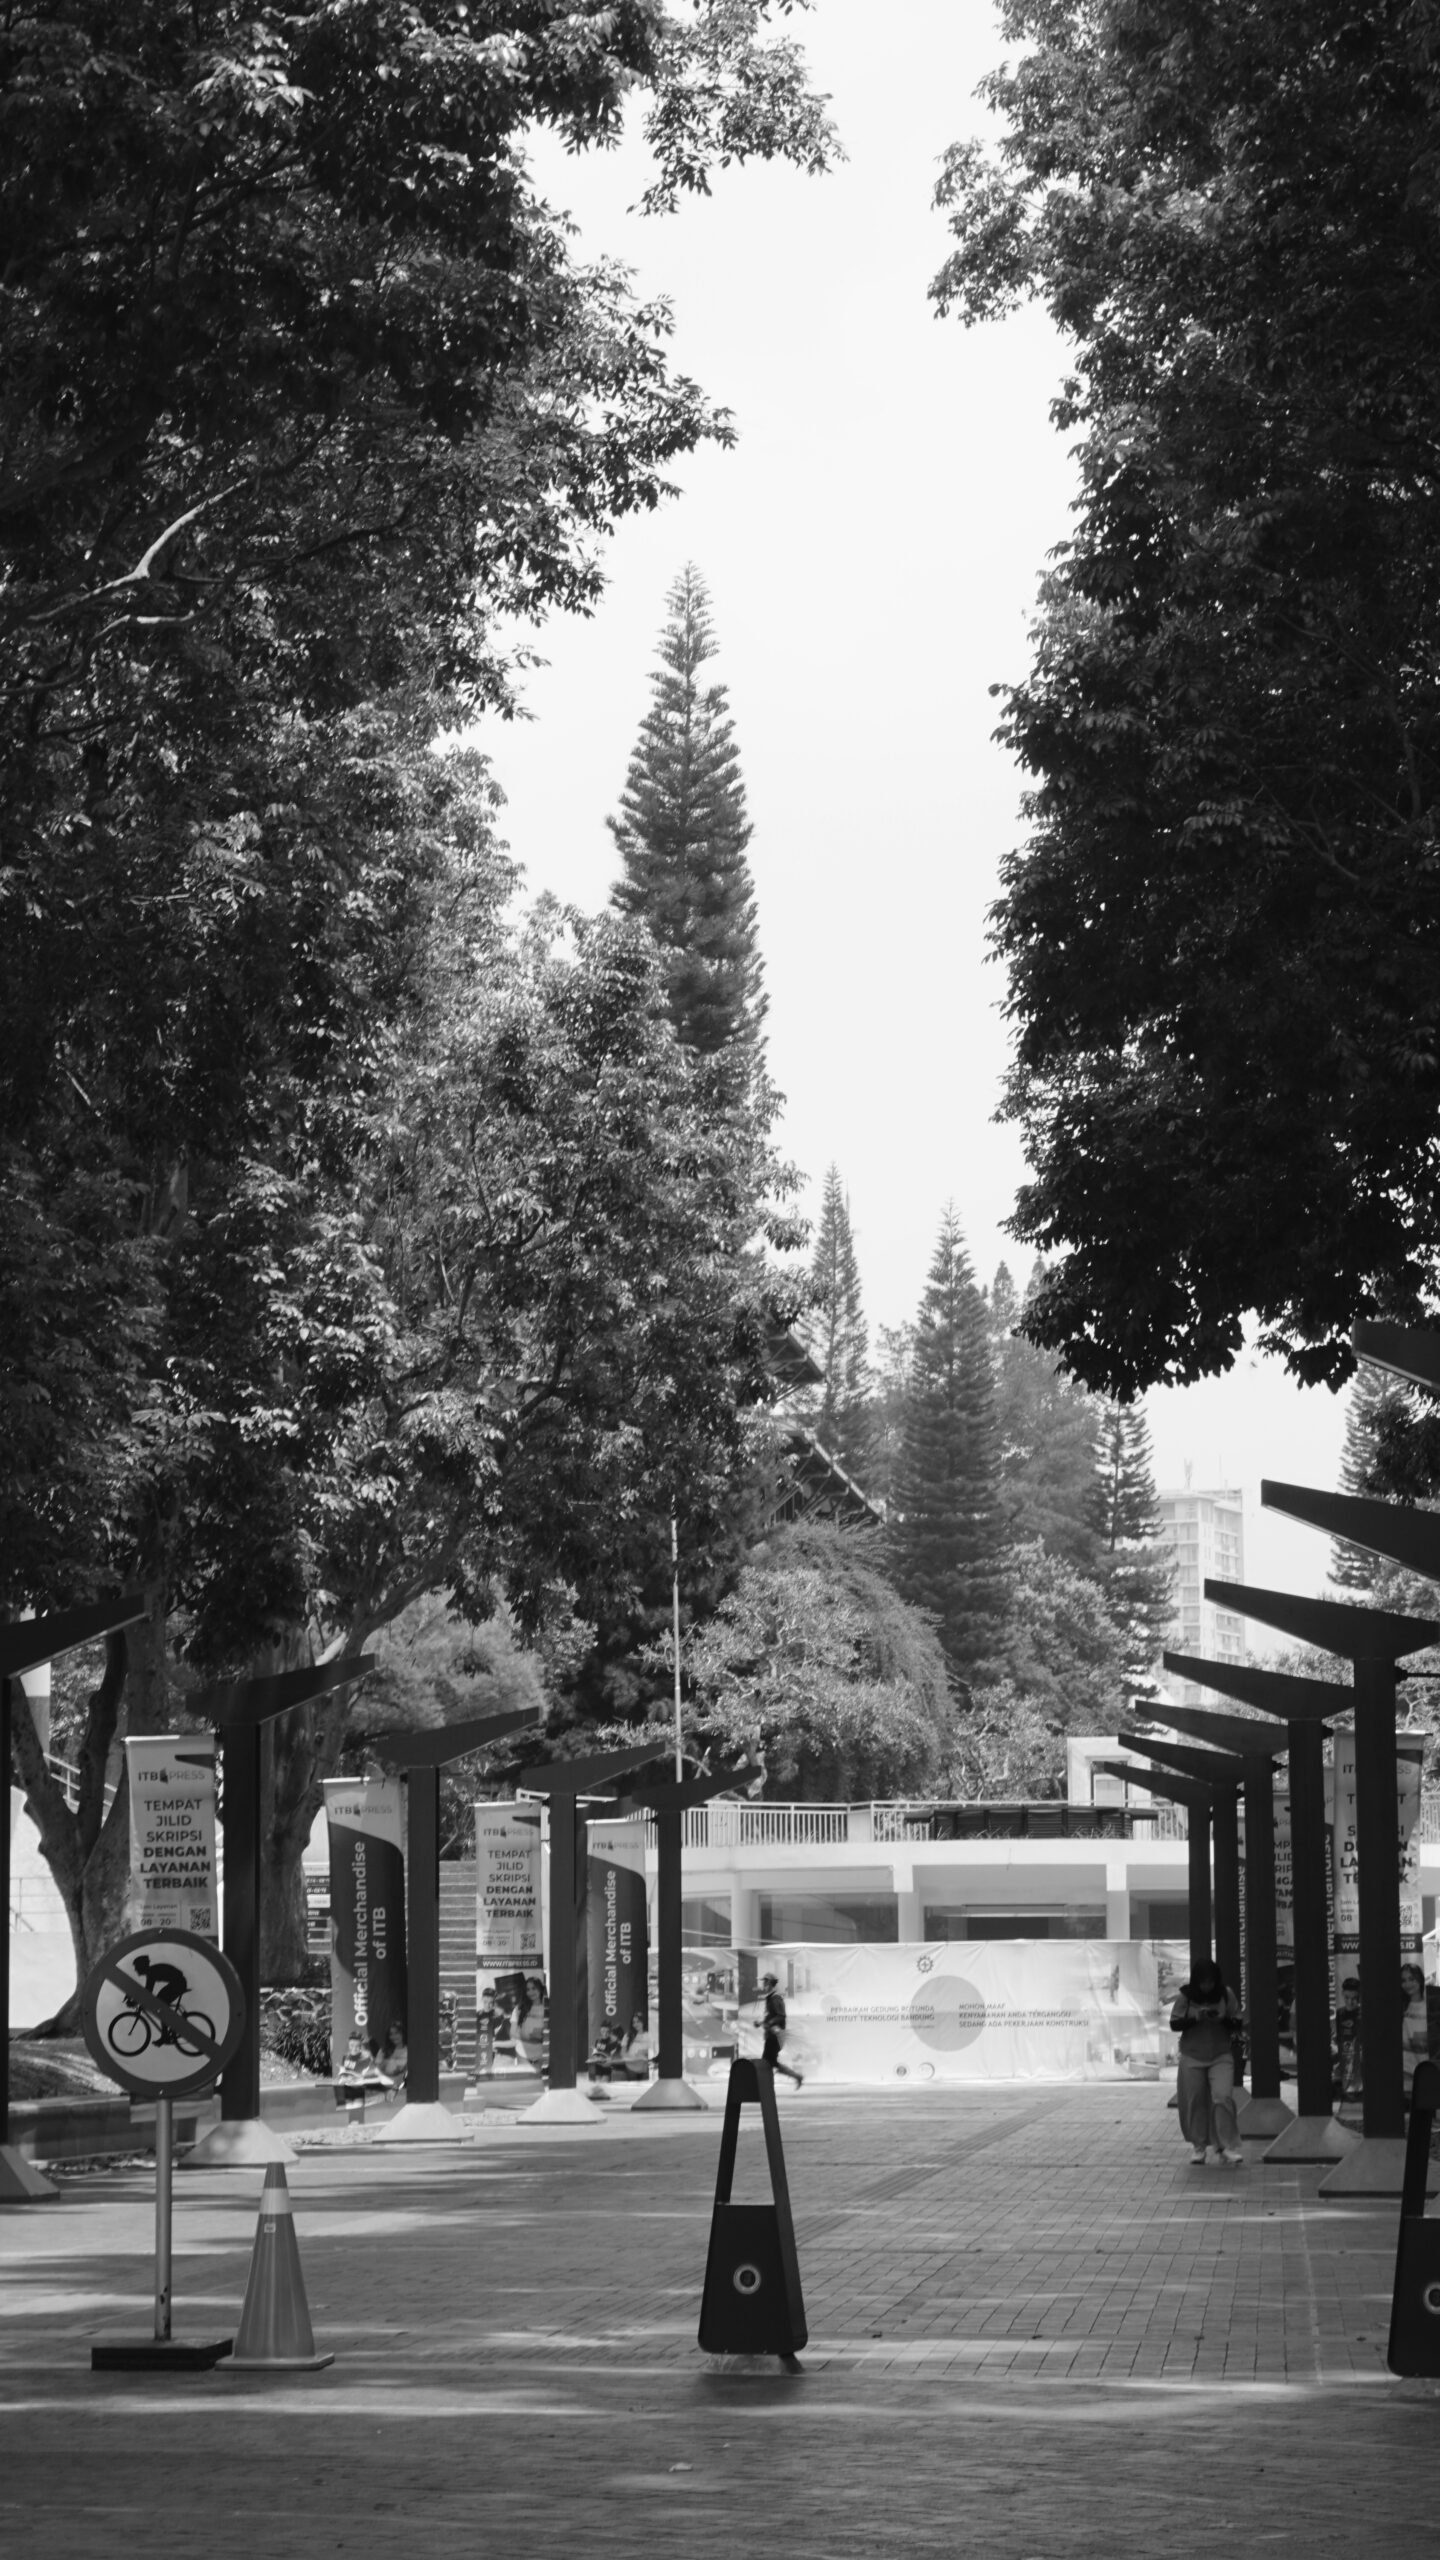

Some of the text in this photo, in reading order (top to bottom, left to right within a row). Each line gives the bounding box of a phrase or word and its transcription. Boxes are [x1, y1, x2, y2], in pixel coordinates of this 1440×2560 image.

[137, 1769, 206, 1781] ITB PRESS
[144, 1799, 202, 1811] TEMPAT
[334, 1807, 353, 1815] ITB
[155, 1814, 192, 1827] JILID
[146, 1830, 202, 1842] SKRIPSI
[143, 1845, 207, 1858] DENGAN
[488, 1849, 531, 1859] TEMPAT
[139, 1861, 211, 1873] LAYANAN
[496, 1862, 524, 1871] JILID
[143, 1877, 208, 1889] TERBAIK
[488, 1873, 530, 1882] SKRIPSI
[486, 1885, 533, 1895] DENGAN
[483, 1897, 536, 1906] LAYANAN
[485, 1909, 534, 1918] TERBAIK
[351, 1841, 369, 2027] Official Merchandise
[372, 1906, 387, 1960] of ITB
[604, 1870, 617, 2017] Official Merchandise
[619, 1921, 632, 1965] of ITB
[830, 2004, 935, 2014] PERBAIKAN GEDUNG ROTUNDA
[1007, 2010, 1027, 2018] ANDA
[1028, 2010, 1071, 2018] TERGANGGU
[860, 2014, 899, 2022] TEKNOLOGI
[900, 2013, 935, 2021] BANDUNG
[958, 2020, 986, 2028] SEDANG
[1046, 2019, 1089, 2027] KONSTRUKSI
